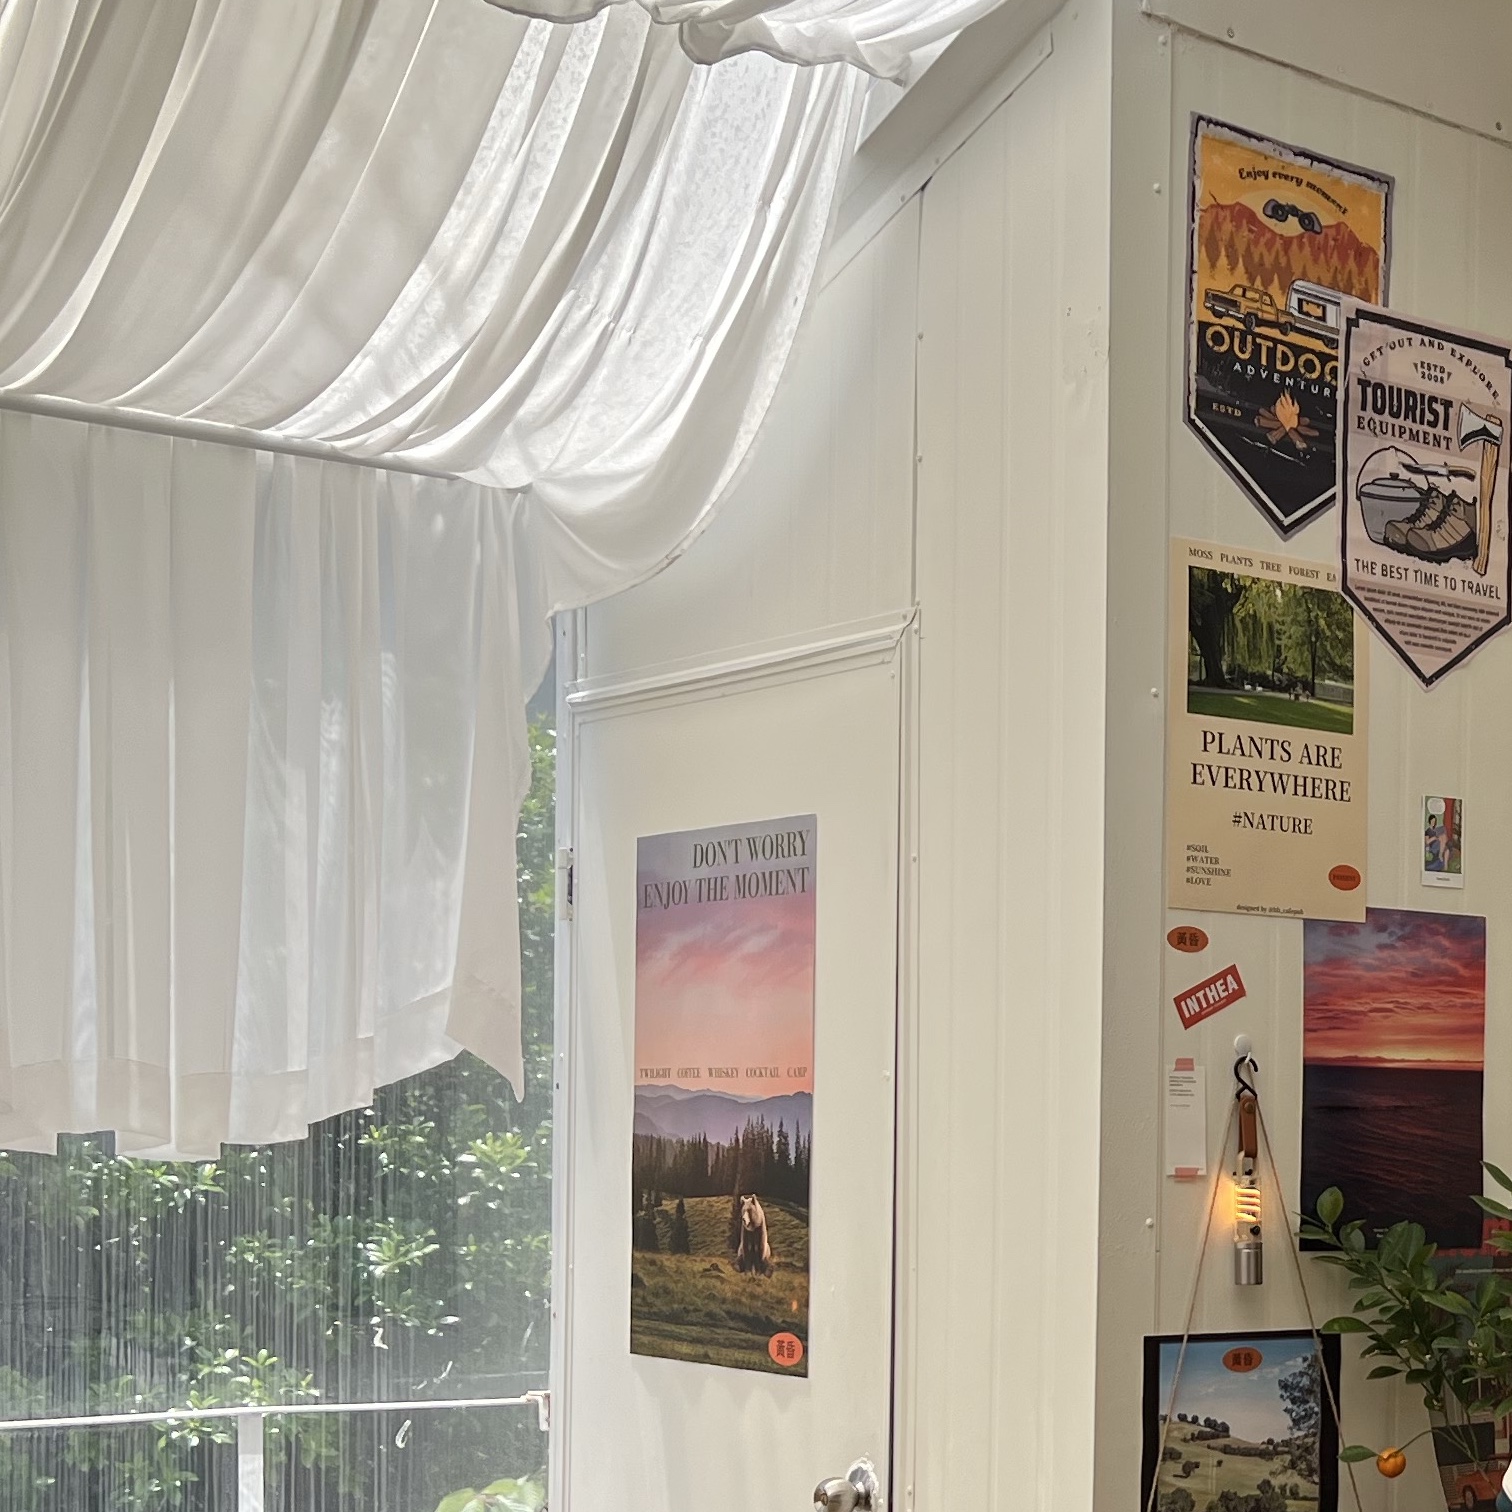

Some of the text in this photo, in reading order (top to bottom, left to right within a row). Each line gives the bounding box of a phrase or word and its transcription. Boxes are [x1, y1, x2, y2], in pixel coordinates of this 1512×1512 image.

[1238, 166, 1348, 215] Enjoy every moment
[1362, 337, 1500, 400] GET OUT AND EXPLORE
[1212, 402, 1242, 417] ESTD
[1357, 377, 1453, 431] TOURIST
[1357, 415, 1453, 450] EQUIPMENT
[1188, 547, 1213, 560] MOSS
[1220, 553, 1253, 568] PLANTS
[1260, 560, 1282, 573] TREE
[1288, 565, 1321, 580] FOREST
[1355, 558, 1501, 600] THE BEST TIME TO TRAVEL
[1201, 730, 1343, 770] PLANTS ARE
[1190, 762, 1351, 803] EVERYWHERE
[1231, 811, 1313, 835] #NATURE
[692, 829, 810, 869] DON'T WORRY
[643, 866, 810, 910] ENJOY THE MOMENT
[1180, 974, 1239, 1018] INTHEA
[676, 1067, 701, 1079] COFFEE
[787, 1066, 808, 1078] CAMP
